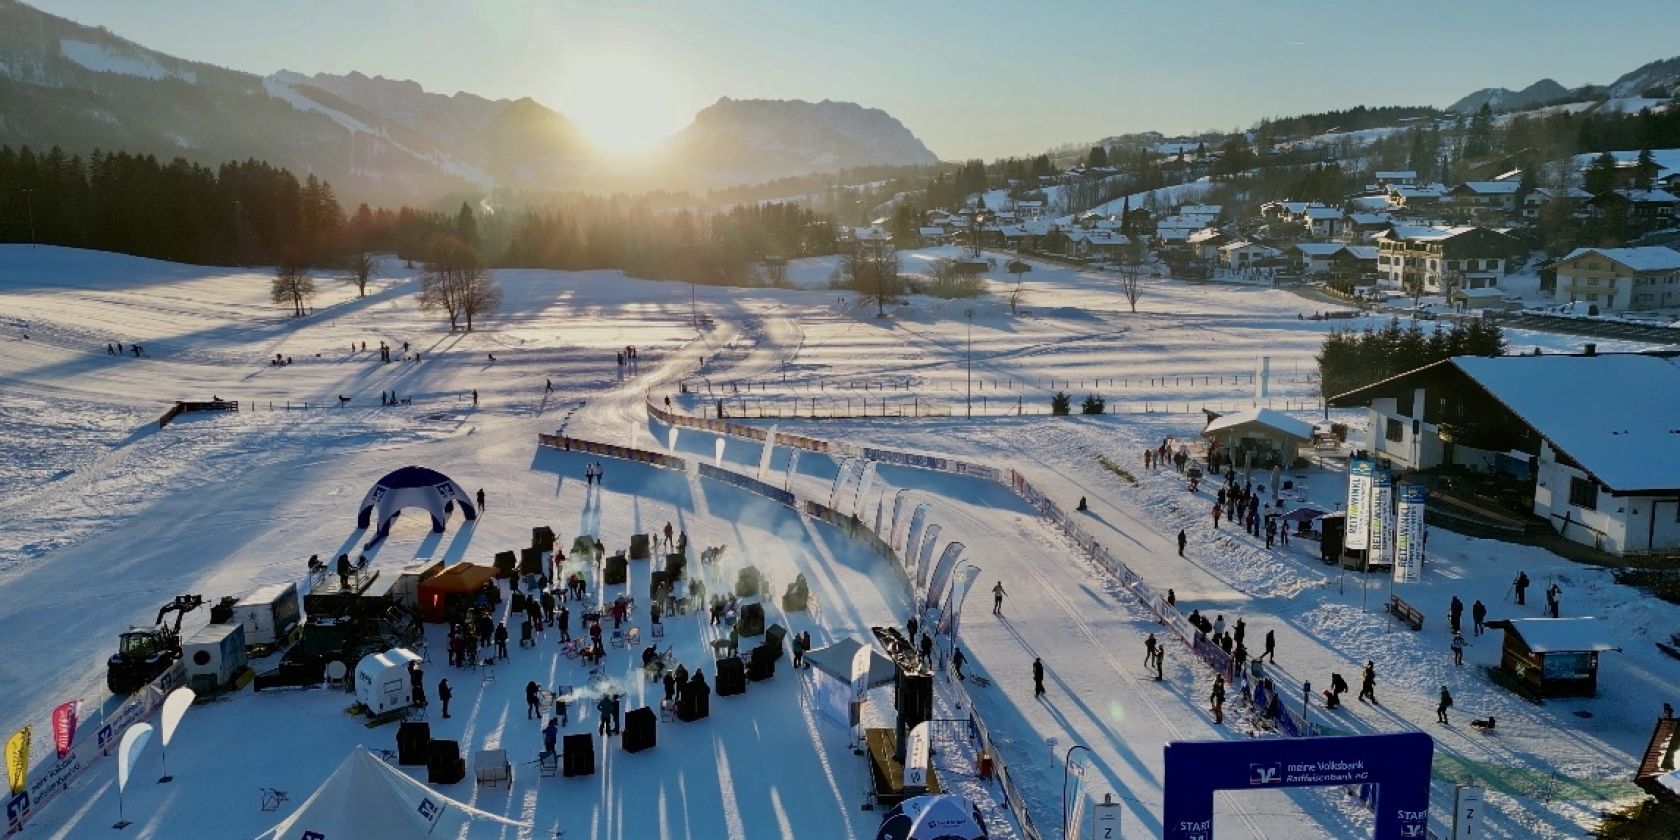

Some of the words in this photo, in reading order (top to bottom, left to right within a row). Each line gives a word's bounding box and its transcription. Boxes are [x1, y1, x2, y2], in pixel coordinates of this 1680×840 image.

[1287, 762, 1316, 772] meine
[1317, 760, 1364, 771] Volksbank
[1286, 772, 1352, 783] Raiffeisenbank
